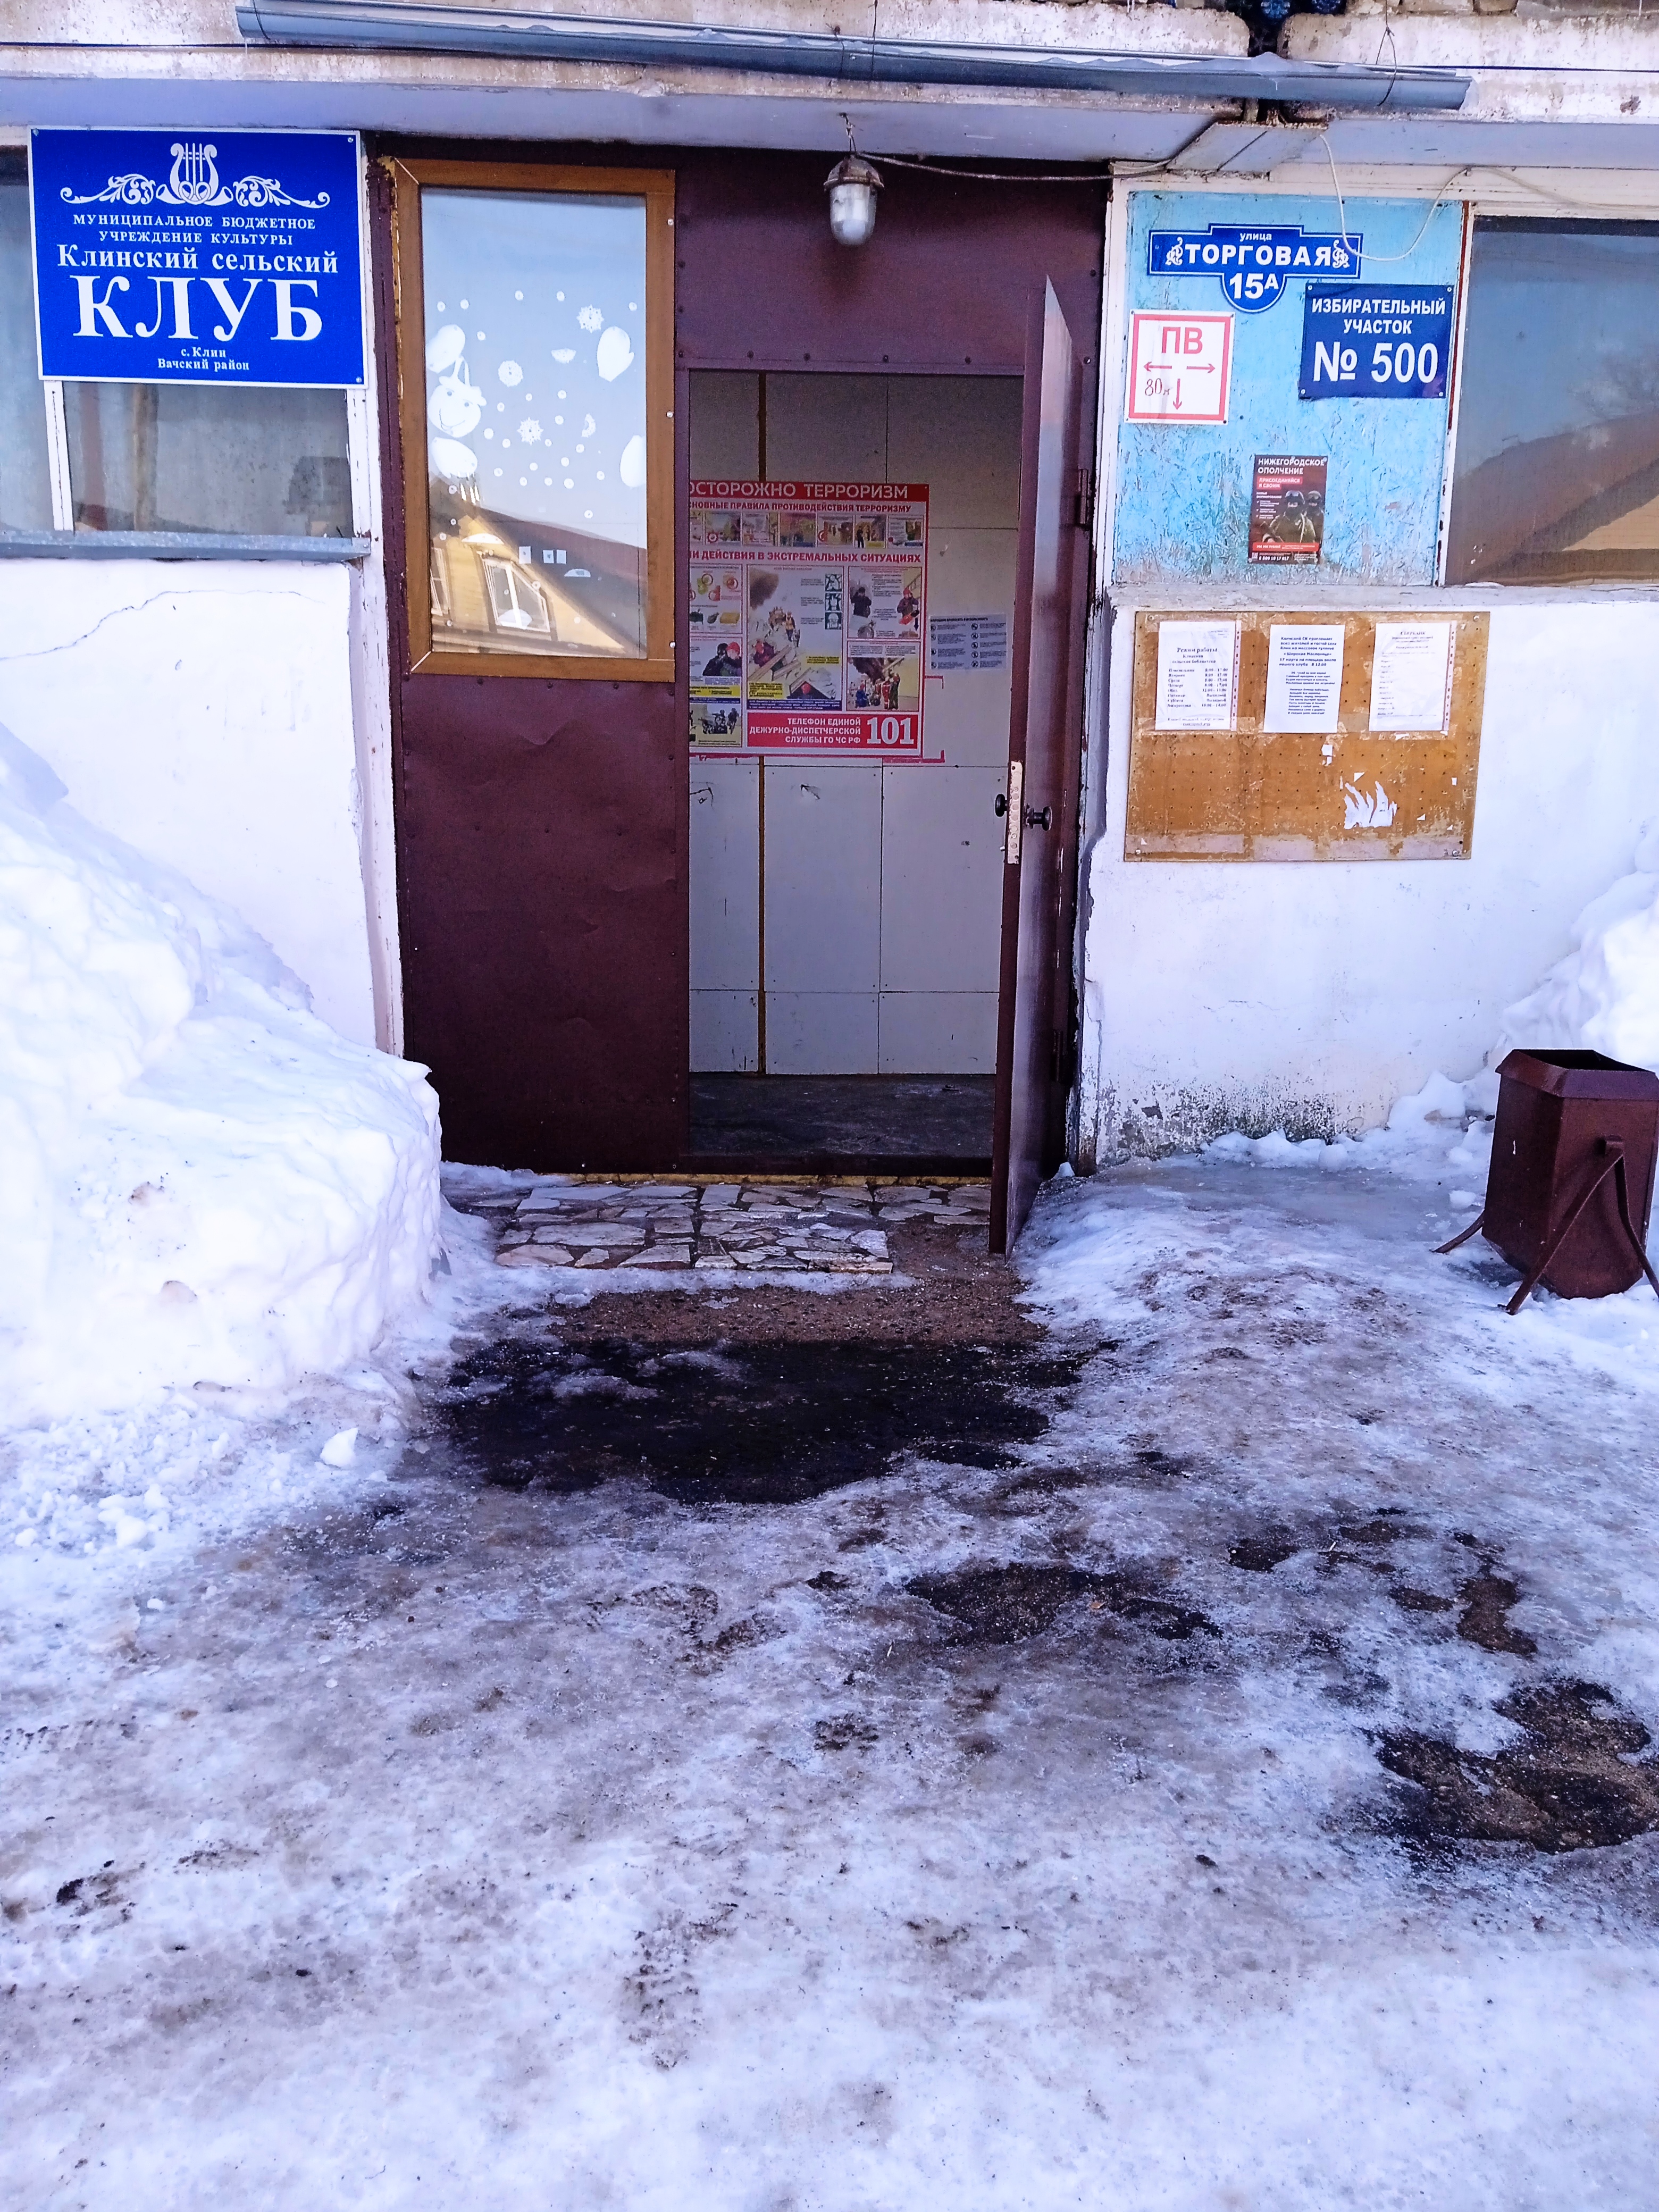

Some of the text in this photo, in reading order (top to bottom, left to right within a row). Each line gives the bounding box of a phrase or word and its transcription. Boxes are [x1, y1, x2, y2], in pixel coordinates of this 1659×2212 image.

[73, 214, 315, 230] МУНИЦИПАЛЬНОЕ БЮДЖЕТНОЕ
[99, 231, 292, 245] УЧРЕЖДЕНИЕ КУЛЬТУРЫ
[1239, 232, 1272, 241] улица
[57, 244, 338, 273] Клинский сельский
[1185, 244, 1331, 266] ТОРГОВАЯ
[70, 275, 322, 341] КЛУБ
[1312, 297, 1445, 315] ИЗБИРАТЕЛЬНЫЙ
[1343, 319, 1412, 334] УЧАСТОК
[1161, 326, 1203, 354] ПВ
[192, 347, 226, 357] Клин
[158, 358, 249, 372] Вачский район
[1313, 341, 1438, 383] № 500
[803, 483, 908, 499] ТЕРРОРИЗМ
[772, 503, 854, 512] ПРОТИВОДЕЙСТВИЯ
[702, 549, 755, 560] ДЕЙСТВИЯ
[768, 552, 858, 562] ЭКСТРЕМАЛЬНЫХ
[861, 554, 921, 563] СИТУАЦИЯХ
[749, 726, 861, 735] ДЕЖУРНО-ДИСПЕТЧЕРСКОЙ
[828, 717, 861, 726] ЕДИНОЙ
[867, 717, 914, 744] 101
